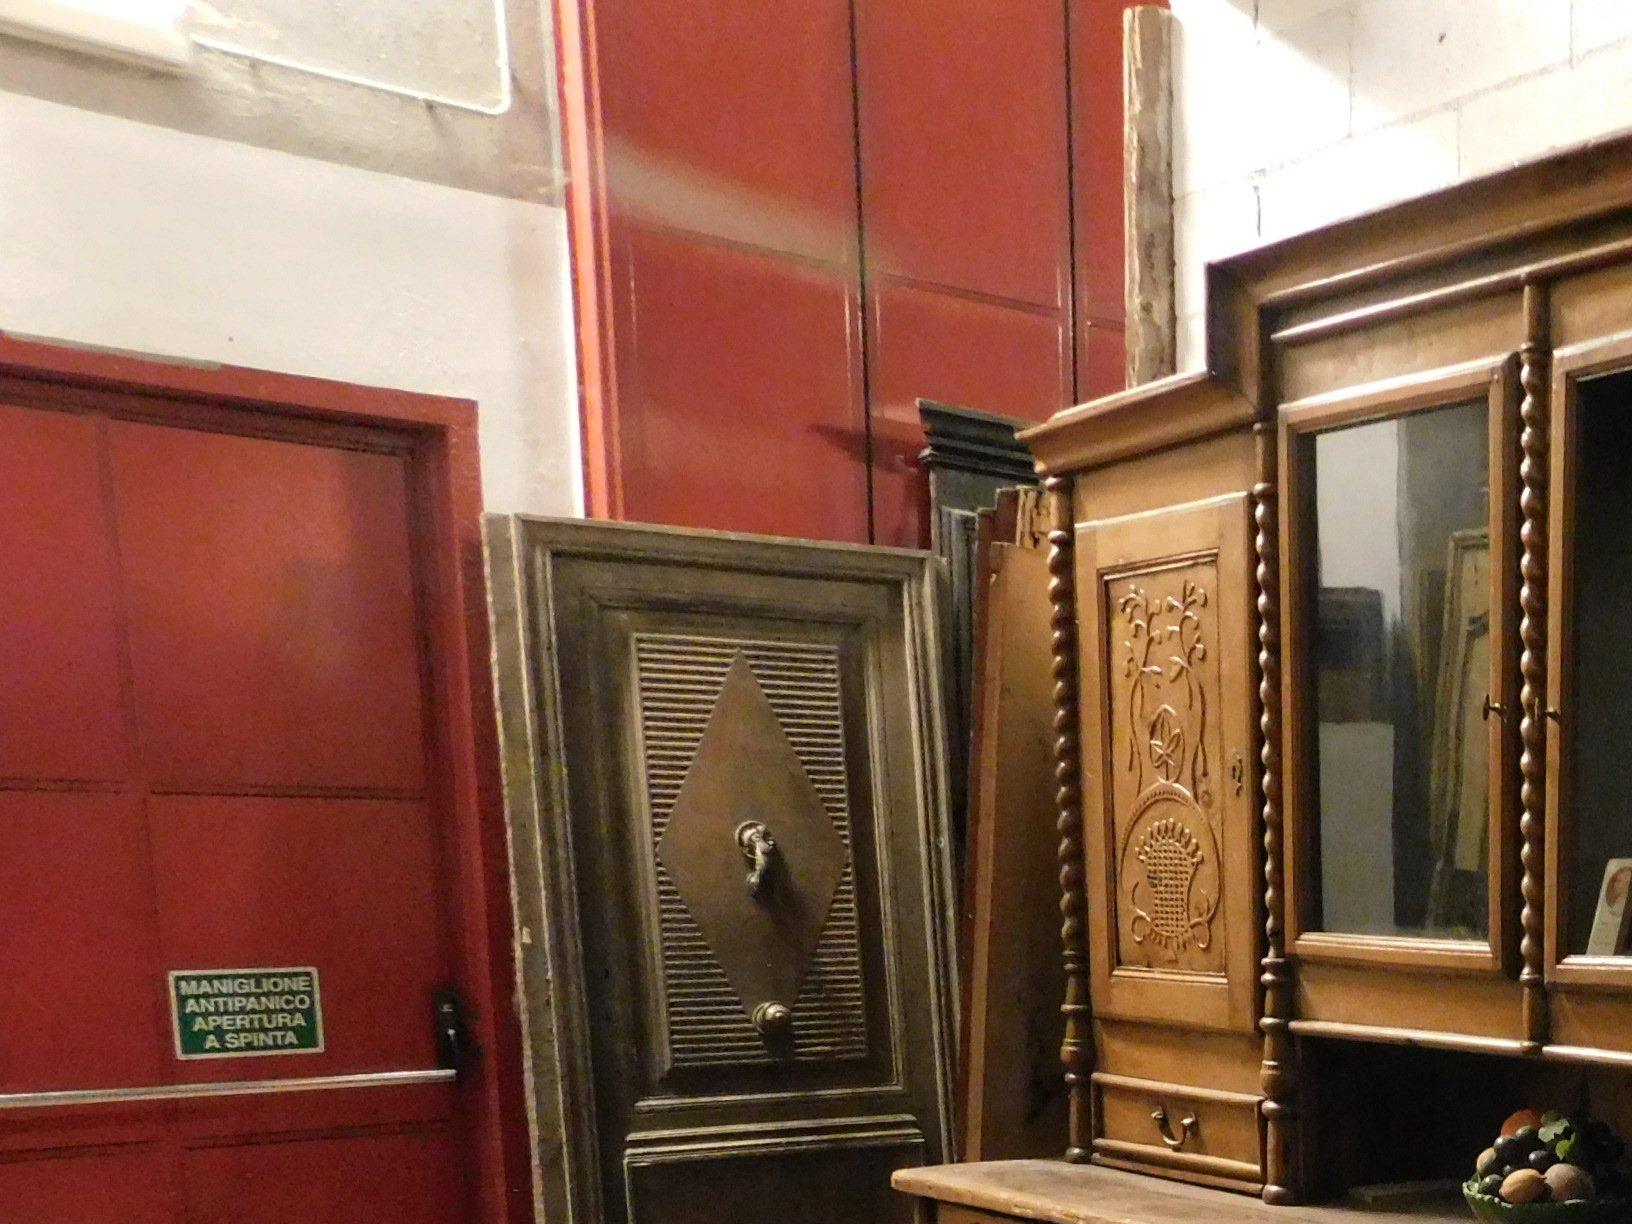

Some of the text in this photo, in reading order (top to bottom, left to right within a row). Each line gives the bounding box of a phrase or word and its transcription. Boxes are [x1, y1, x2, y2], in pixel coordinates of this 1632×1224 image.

[179, 976, 311, 995] MANIGLIONE
[185, 994, 310, 1013] ANTIPANICO
[192, 1012, 307, 1031] APERTURA
[204, 1030, 299, 1049] A SPINTA
